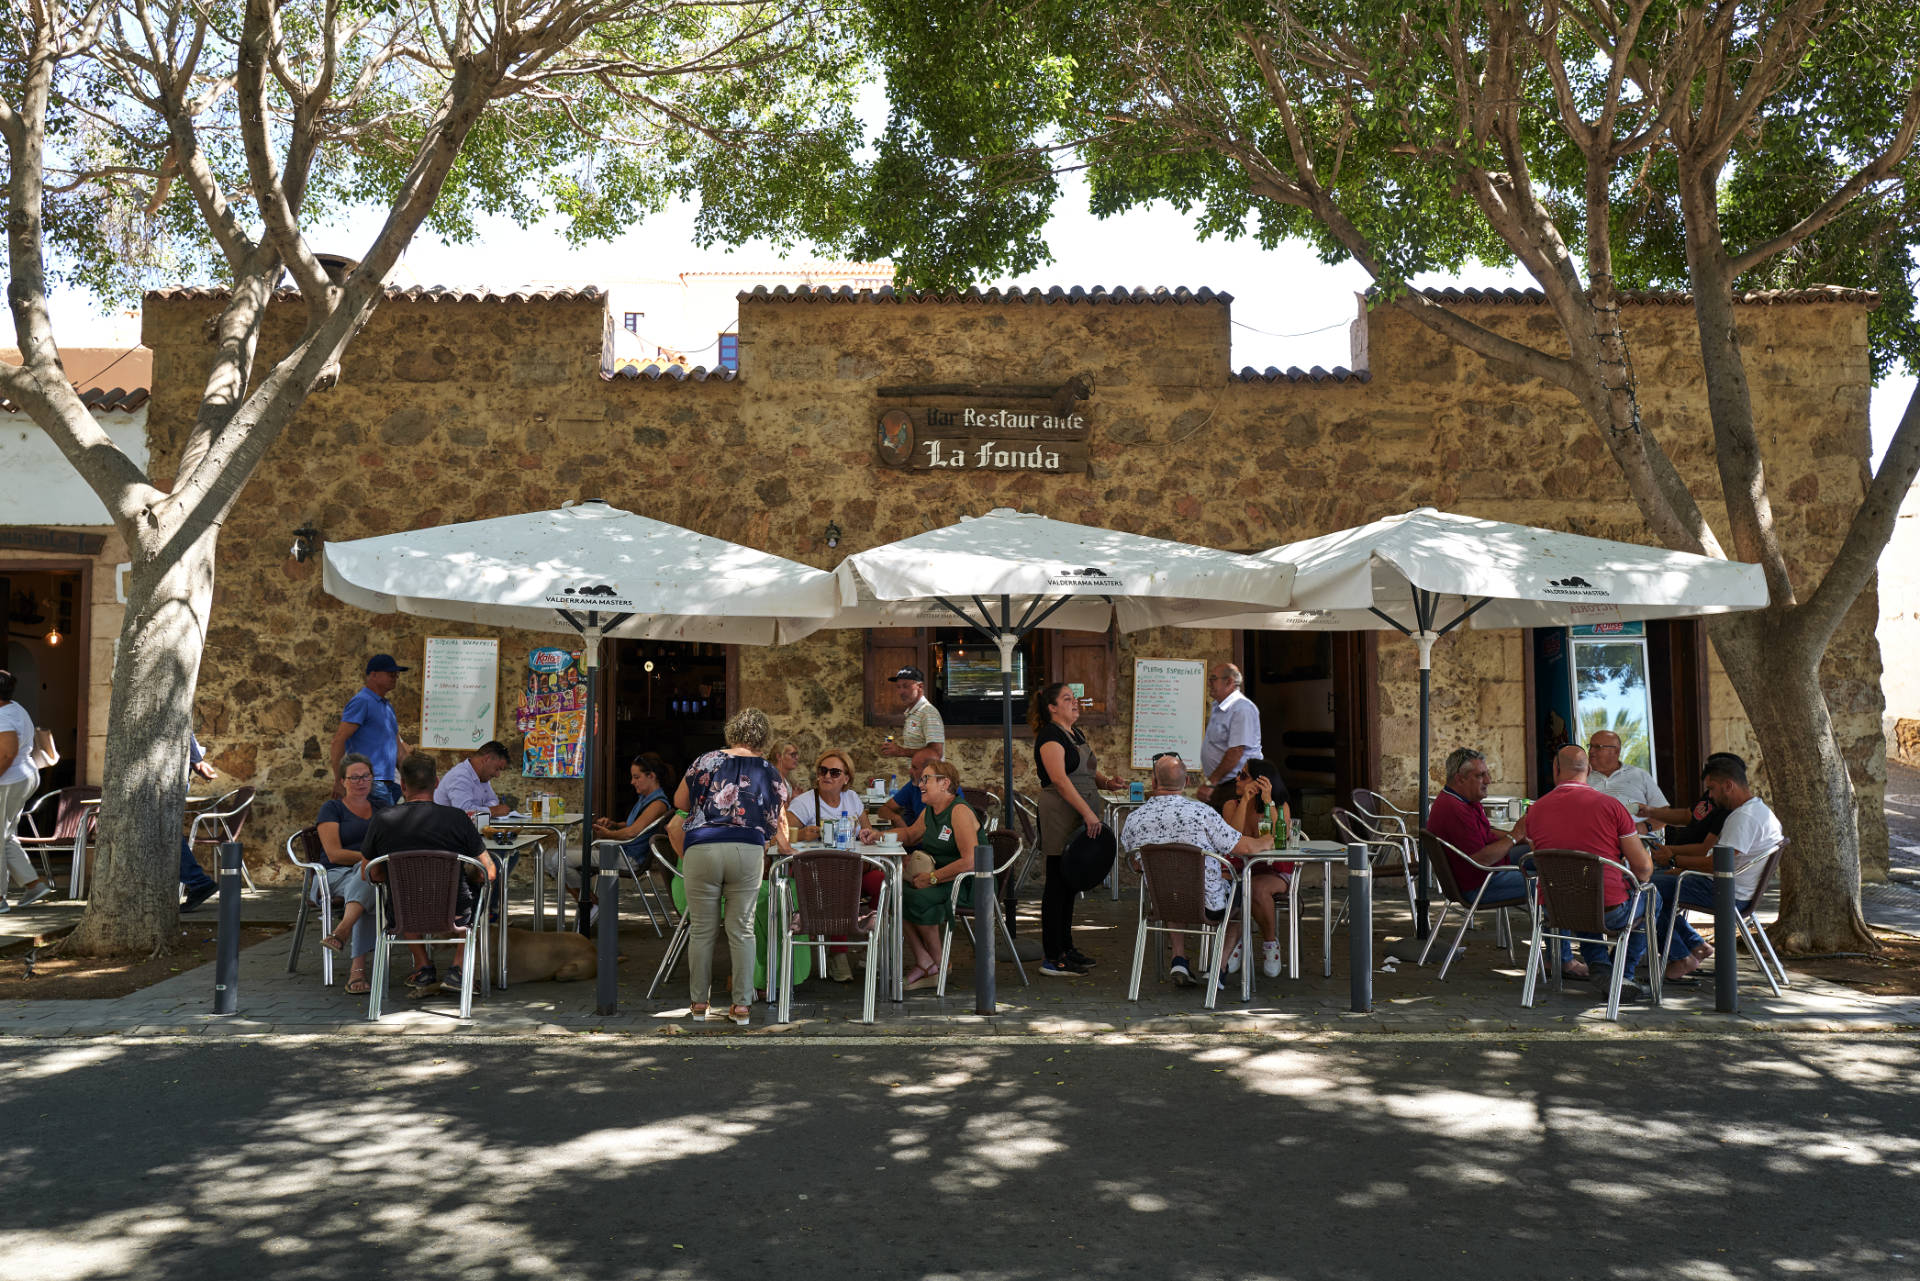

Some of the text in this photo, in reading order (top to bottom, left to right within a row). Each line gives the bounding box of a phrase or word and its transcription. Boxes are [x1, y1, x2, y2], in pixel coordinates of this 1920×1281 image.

[927, 407, 1084, 429] Bar Restaurante
[922, 440, 965, 467] La
[545, 595, 598, 605] VALDERRAMA
[1543, 588, 1582, 596] VALDERRAMA
